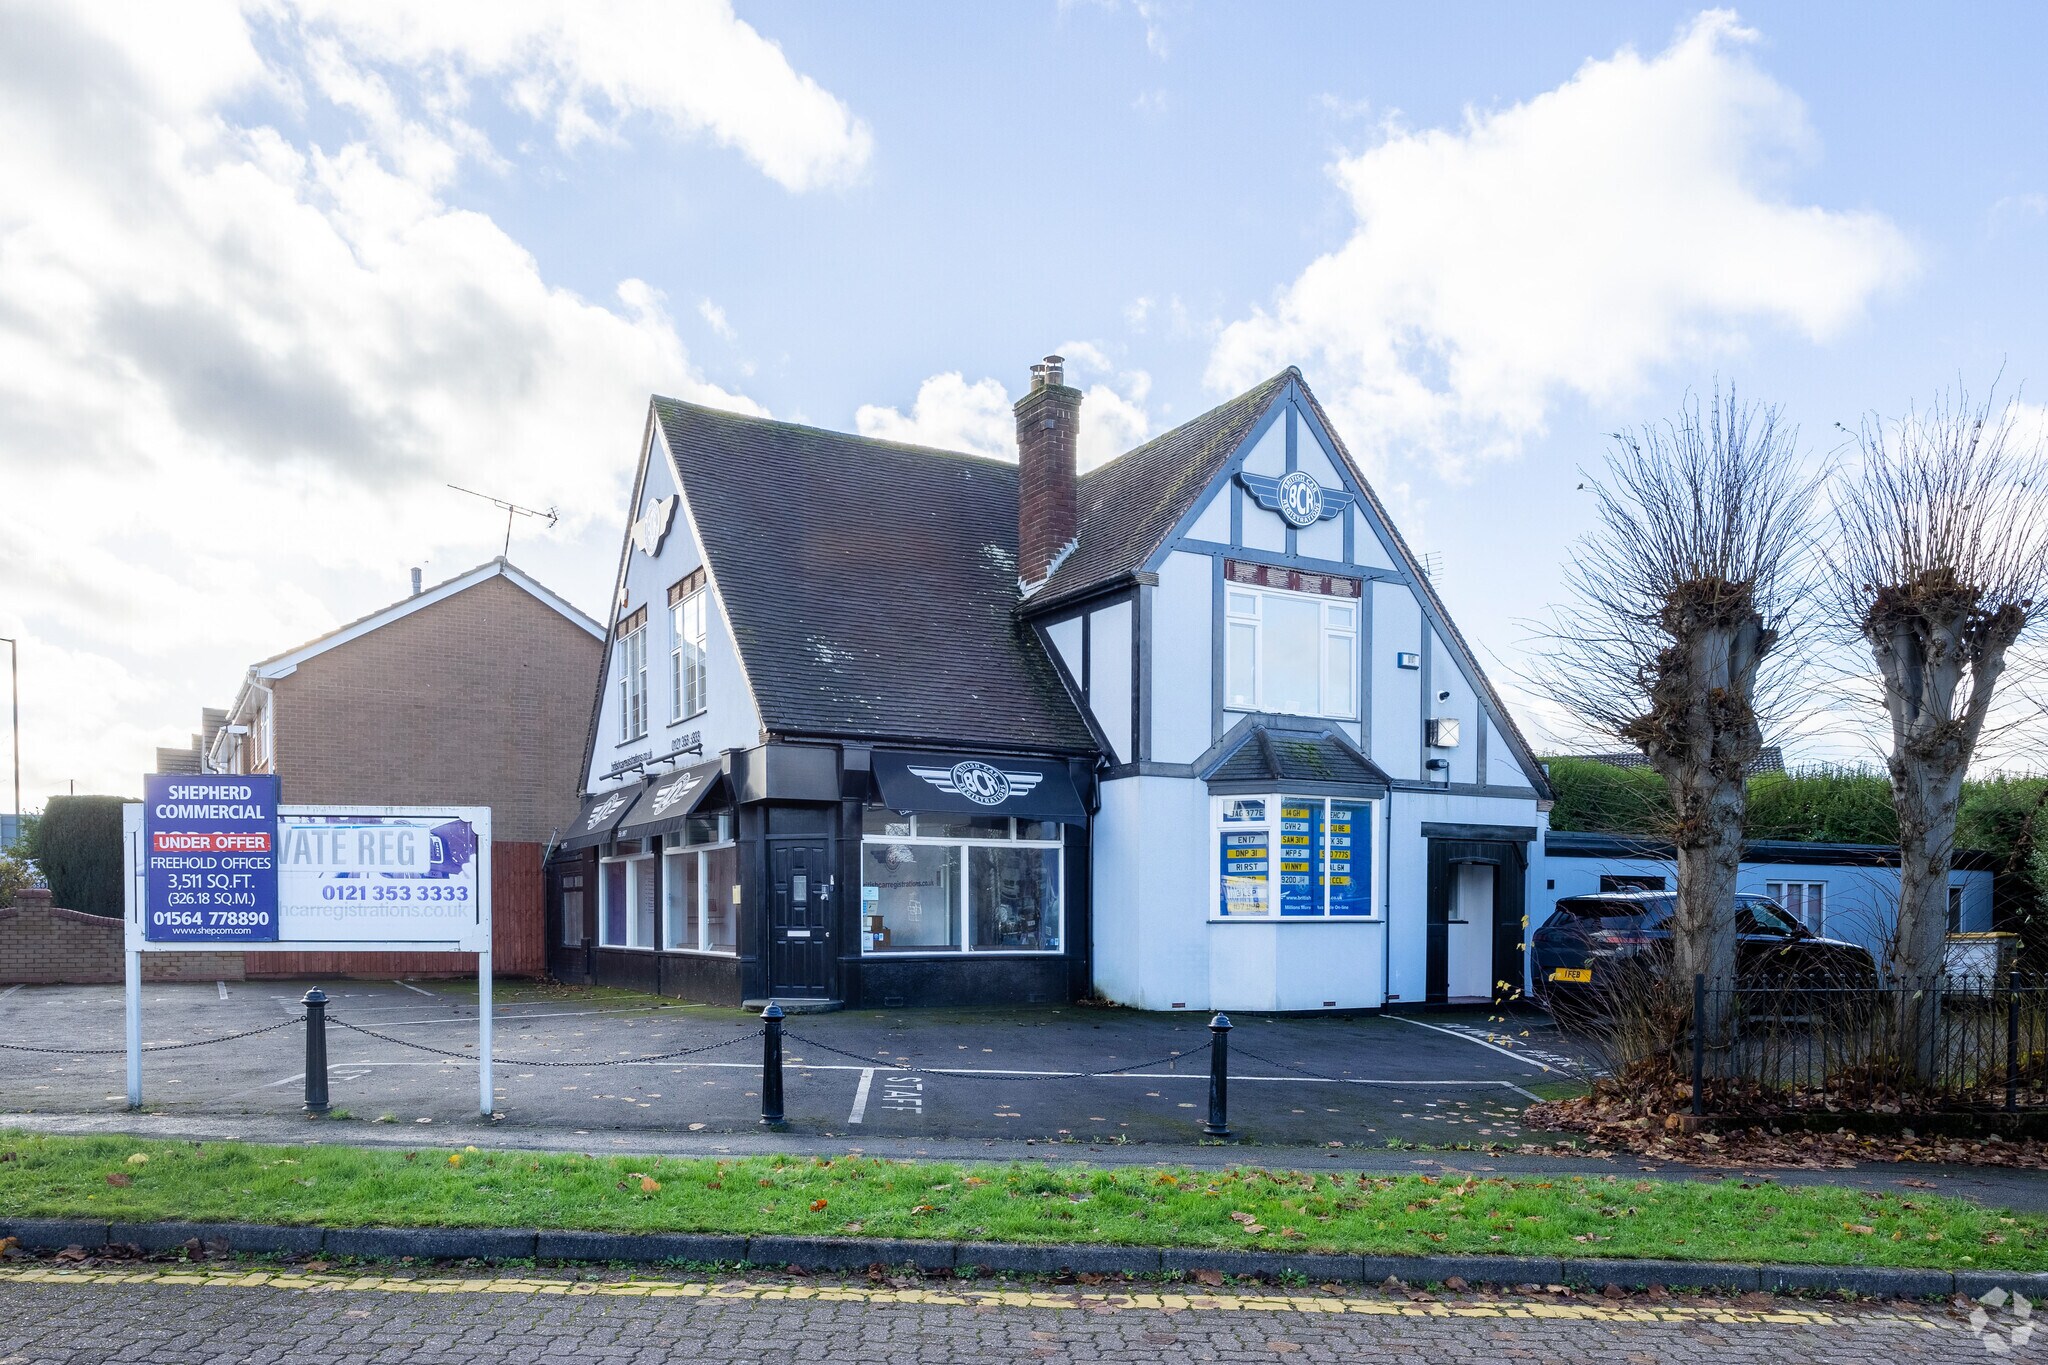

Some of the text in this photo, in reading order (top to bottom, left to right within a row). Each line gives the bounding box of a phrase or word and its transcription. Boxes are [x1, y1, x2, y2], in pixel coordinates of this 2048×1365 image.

[1290, 483, 1314, 514] BCR
[963, 769, 998, 797] BCR
[168, 785, 252, 800] SHEPHERD
[155, 804, 265, 819] COMMERCIAL
[159, 836, 211, 849] UNDER
[215, 836, 265, 849] OFFER
[358, 830, 415, 866] REG
[151, 857, 271, 869] FREEHOLD OFFICES
[168, 874, 255, 890] 3,511 SQ.FT.
[168, 893, 256, 906] (326.18 SQ.M.)
[322, 885, 469, 900] 0121 353 3333
[153, 911, 270, 926] 01564 778890
[279, 902, 467, 921] hcarregistrations.co.uk
[172, 927, 251, 936] www.shepcom.com
[881, 1076, 923, 1114] STAFF
